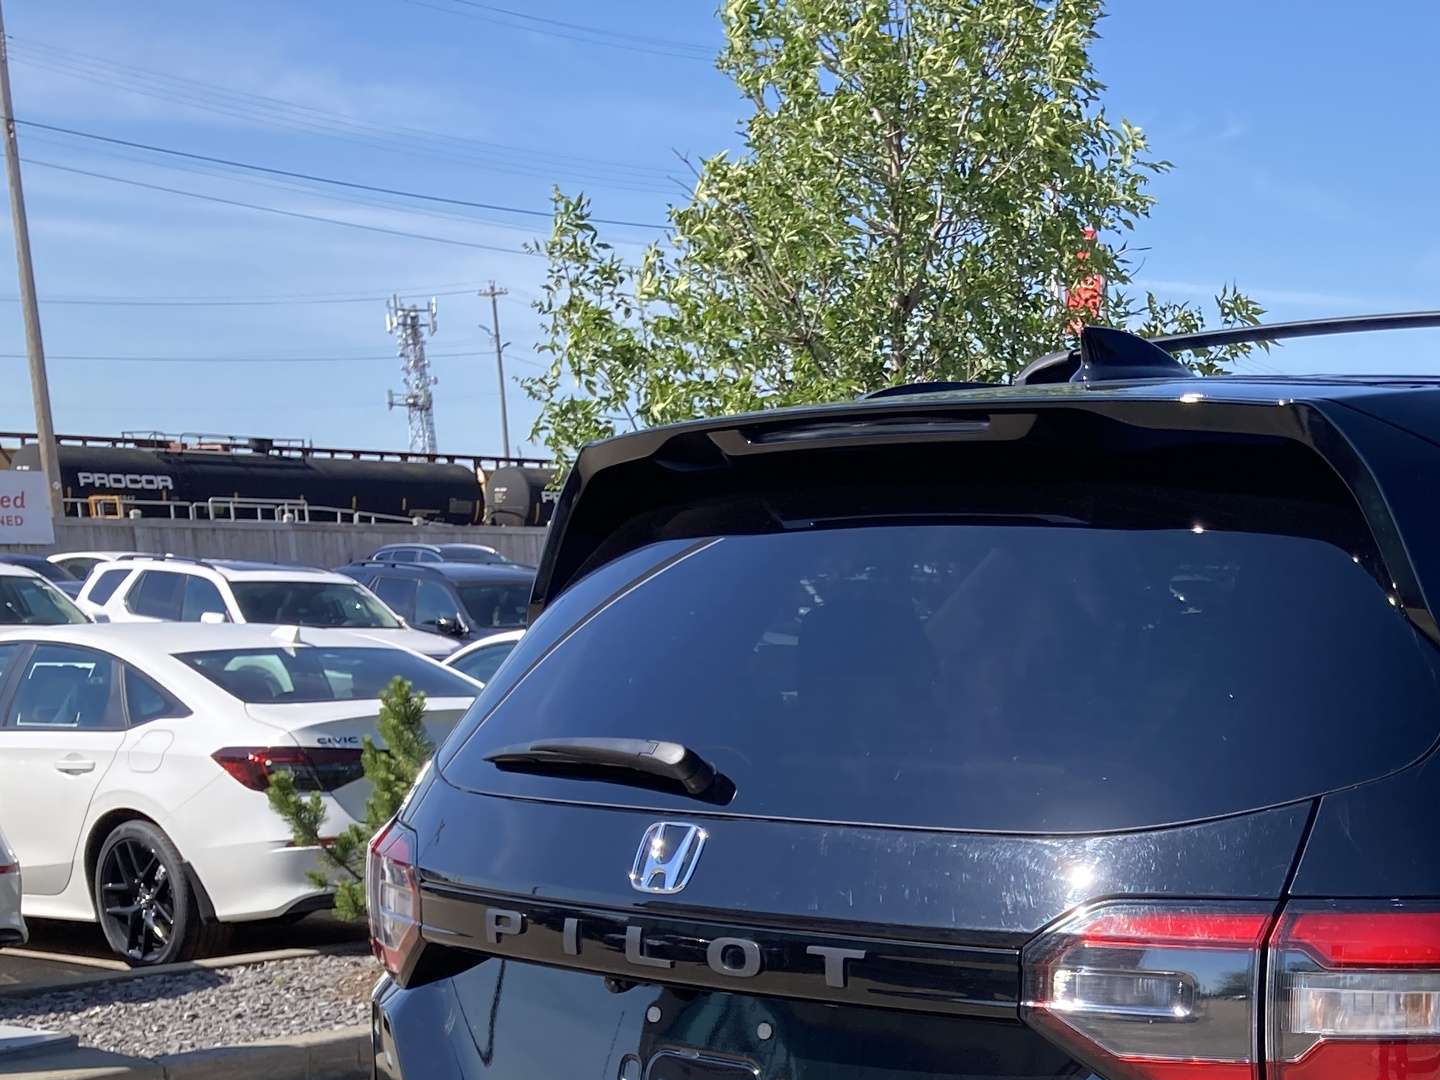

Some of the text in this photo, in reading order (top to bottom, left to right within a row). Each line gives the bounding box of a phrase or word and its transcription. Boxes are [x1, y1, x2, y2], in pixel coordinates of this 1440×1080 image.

[77, 472, 174, 490] PROCOR
[0, 491, 26, 508] ed
[317, 736, 358, 744] CIVIC
[485, 907, 867, 988] PILOT
